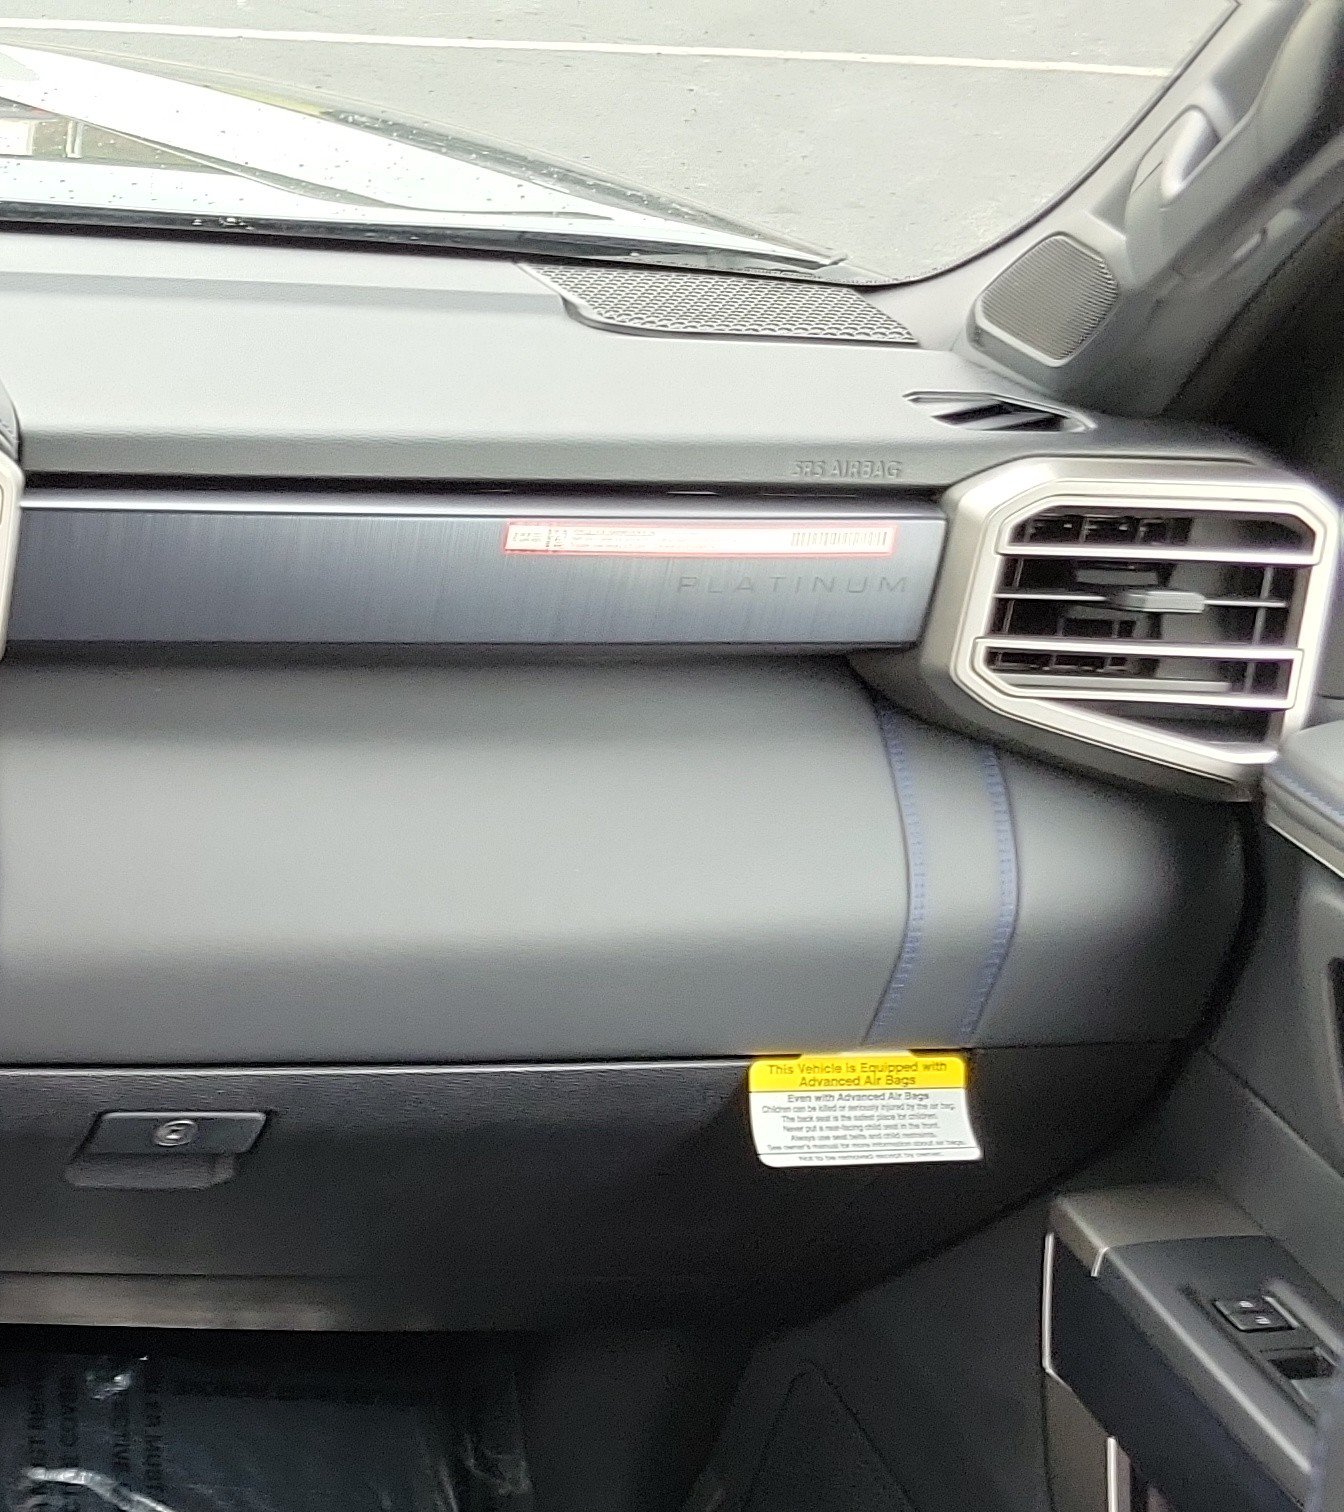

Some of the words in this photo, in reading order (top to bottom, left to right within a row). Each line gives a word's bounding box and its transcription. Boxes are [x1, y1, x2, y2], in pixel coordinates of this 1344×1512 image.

[792, 460, 827, 478] SRS
[830, 460, 904, 479] AIRBAG
[675, 573, 910, 595] PLATINUM
[768, 1064, 794, 1075] This
[798, 1062, 842, 1074] Vehicle
[860, 1061, 918, 1076] Equipped
[922, 1061, 948, 1072] with
[799, 1075, 860, 1088] Advanced
[863, 1074, 881, 1086] Air
[885, 1074, 916, 1088] Bags
[787, 1093, 812, 1103] Even
[814, 1093, 835, 1102] with
[837, 1091, 886, 1102] Advanced
[887, 1091, 902, 1101] Air
[904, 1091, 930, 1102] Bags
